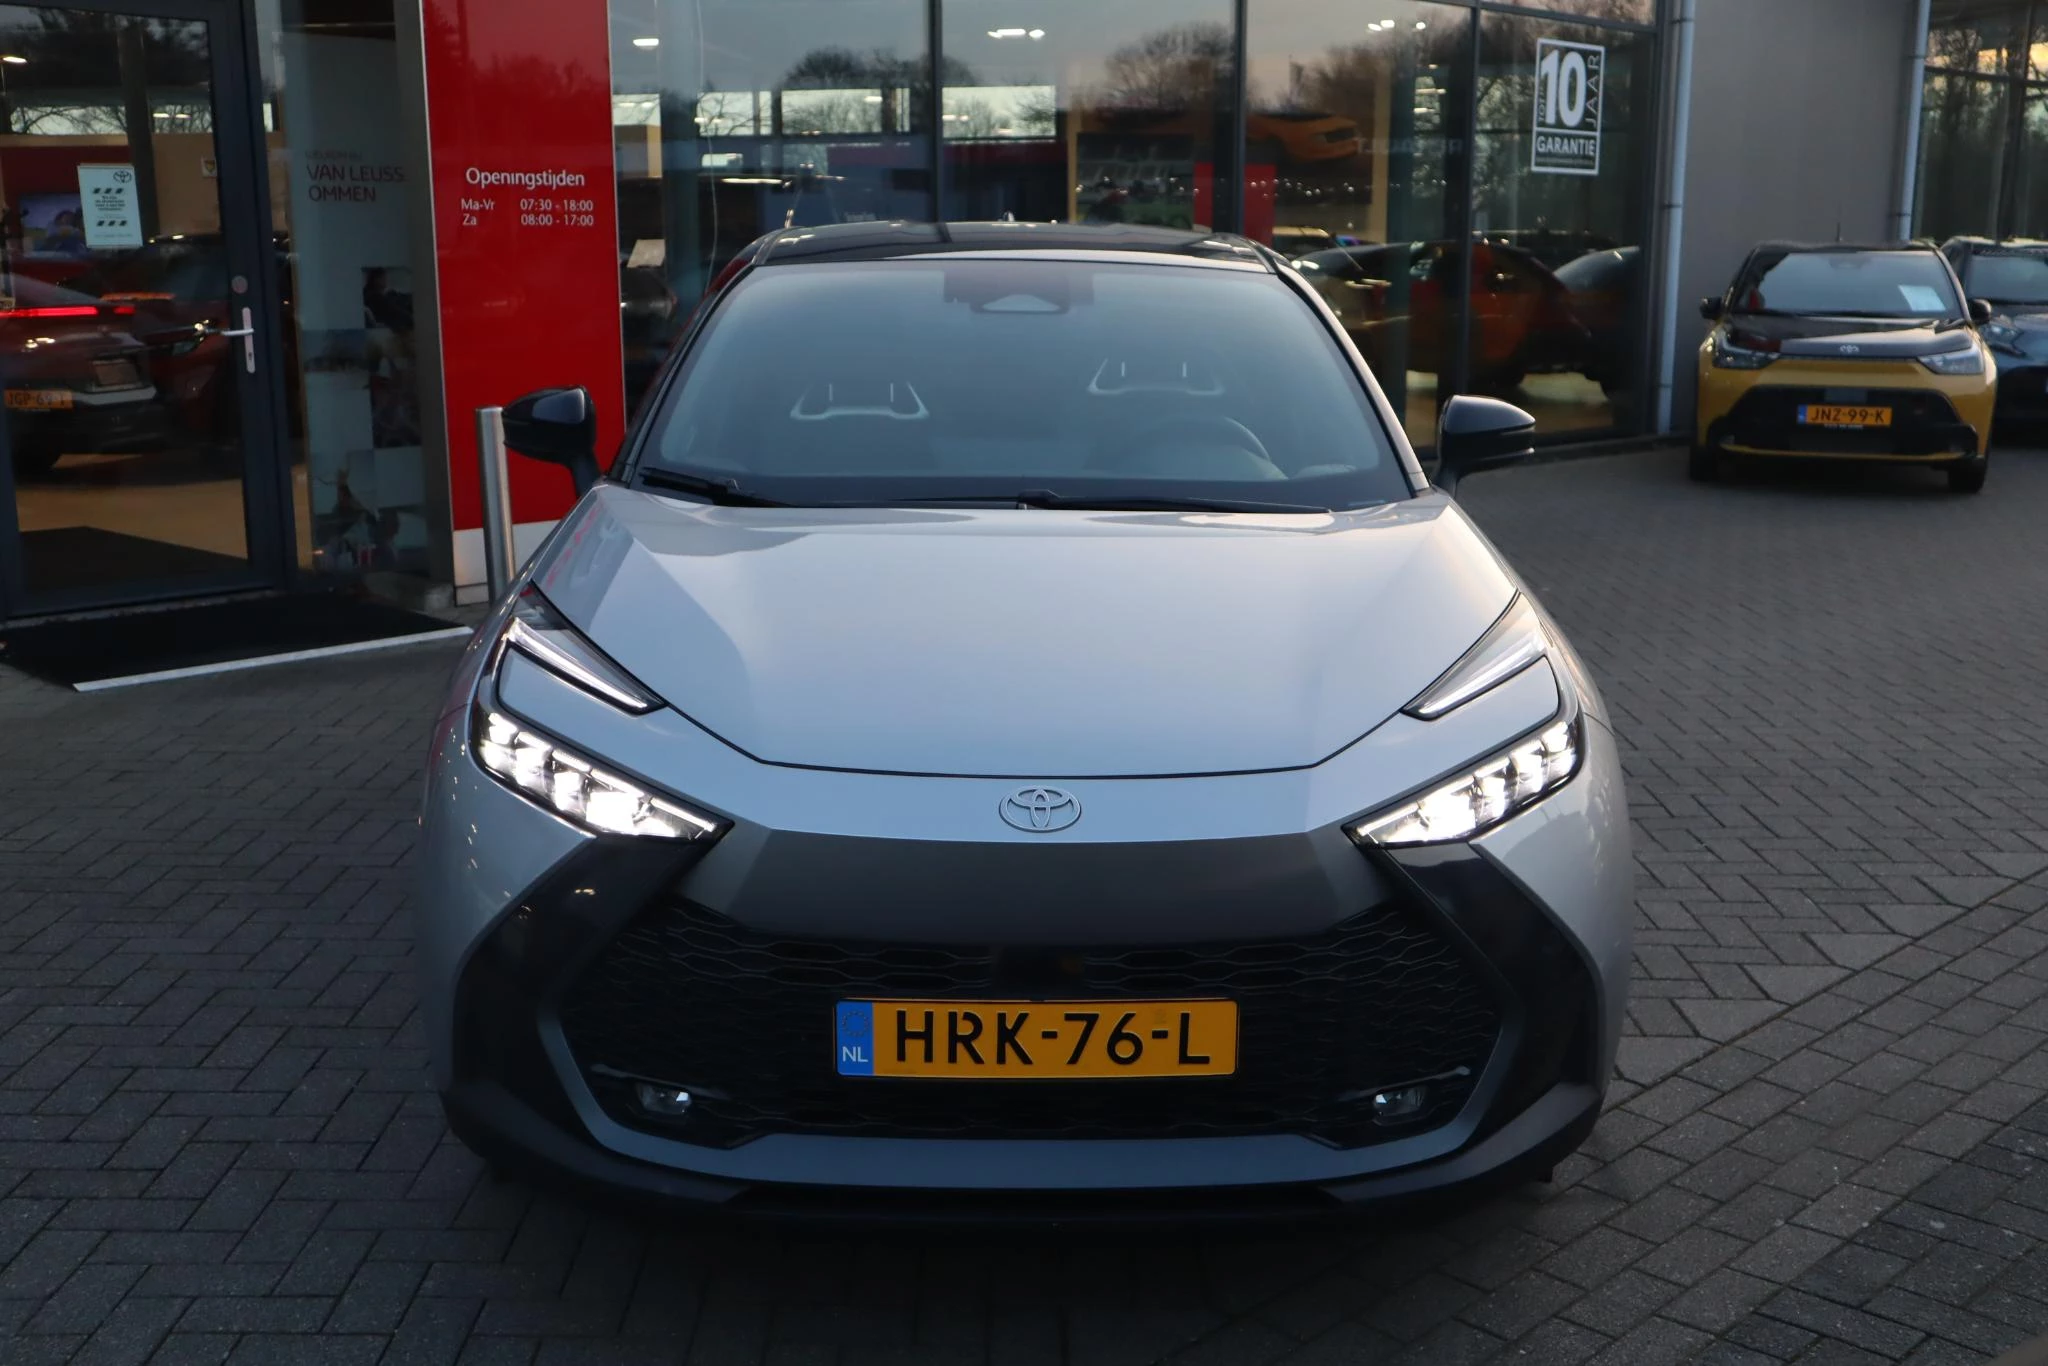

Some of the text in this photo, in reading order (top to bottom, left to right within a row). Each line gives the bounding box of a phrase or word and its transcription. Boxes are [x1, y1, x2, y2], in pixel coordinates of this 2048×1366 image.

[1541, 49, 1586, 127] 10
[1585, 54, 1600, 128] JAAR
[1536, 135, 1596, 156] GARANTIE
[306, 164, 406, 182] VAN LEUSS
[465, 167, 586, 190] Openingstijden
[308, 184, 377, 202] OMMEN
[461, 198, 496, 211] Ma-Vr
[520, 198, 552, 211] 07:30
[563, 199, 594, 212] 18:00
[462, 213, 477, 225] Za
[521, 213, 553, 226] 08:00
[564, 214, 594, 226] 17:00
[1811, 407, 1885, 423] JNZ-99-K
[896, 1008, 1211, 1065] HRK-76-L
[841, 1045, 869, 1063] NL
